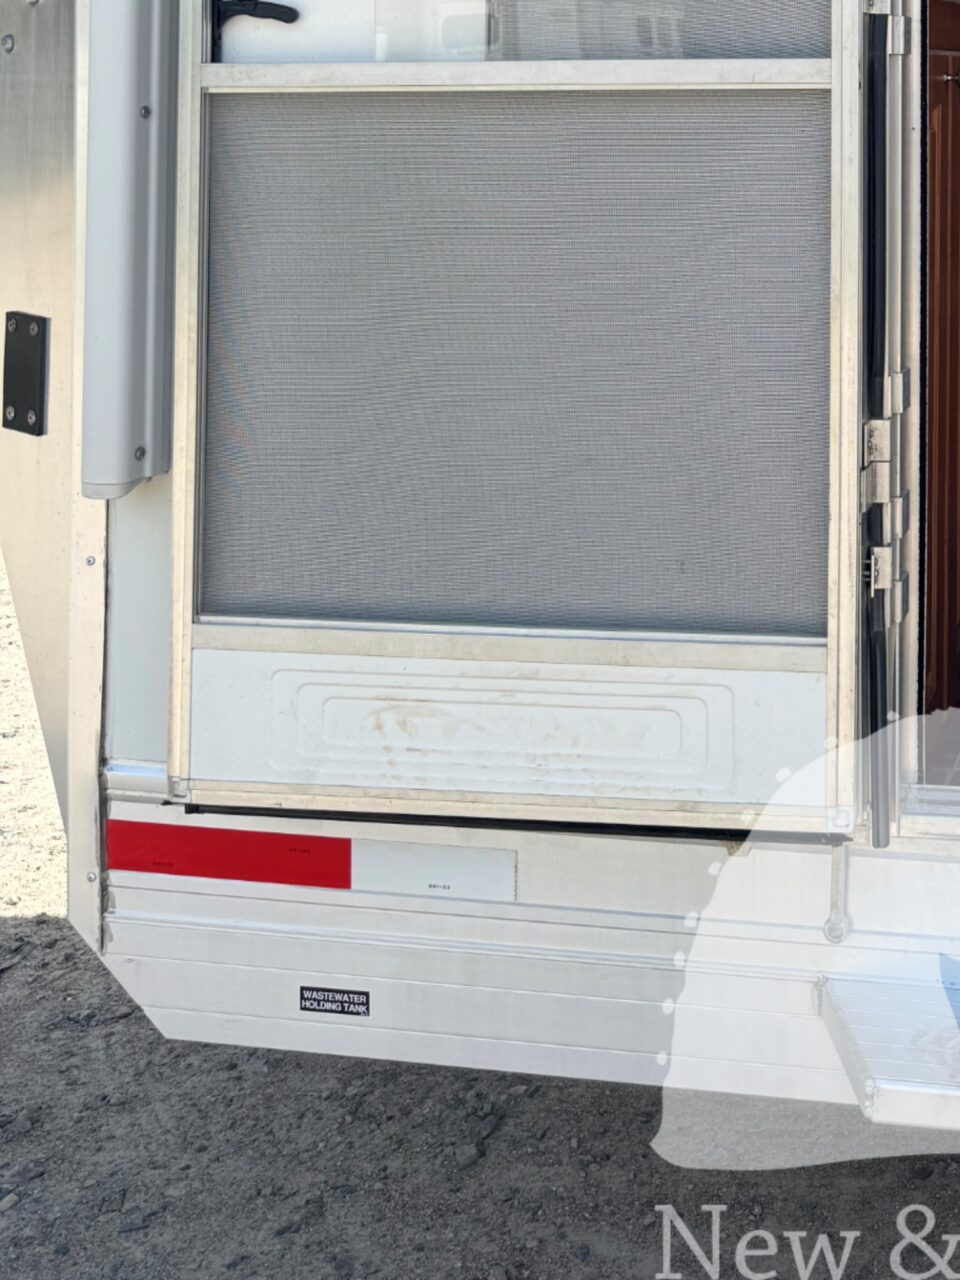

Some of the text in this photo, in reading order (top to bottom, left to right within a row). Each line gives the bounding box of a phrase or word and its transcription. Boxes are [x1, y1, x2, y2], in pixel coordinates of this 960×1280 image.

[303, 990, 366, 1004] WASTEWATER
[302, 1000, 368, 1013] HOLDING TANK
